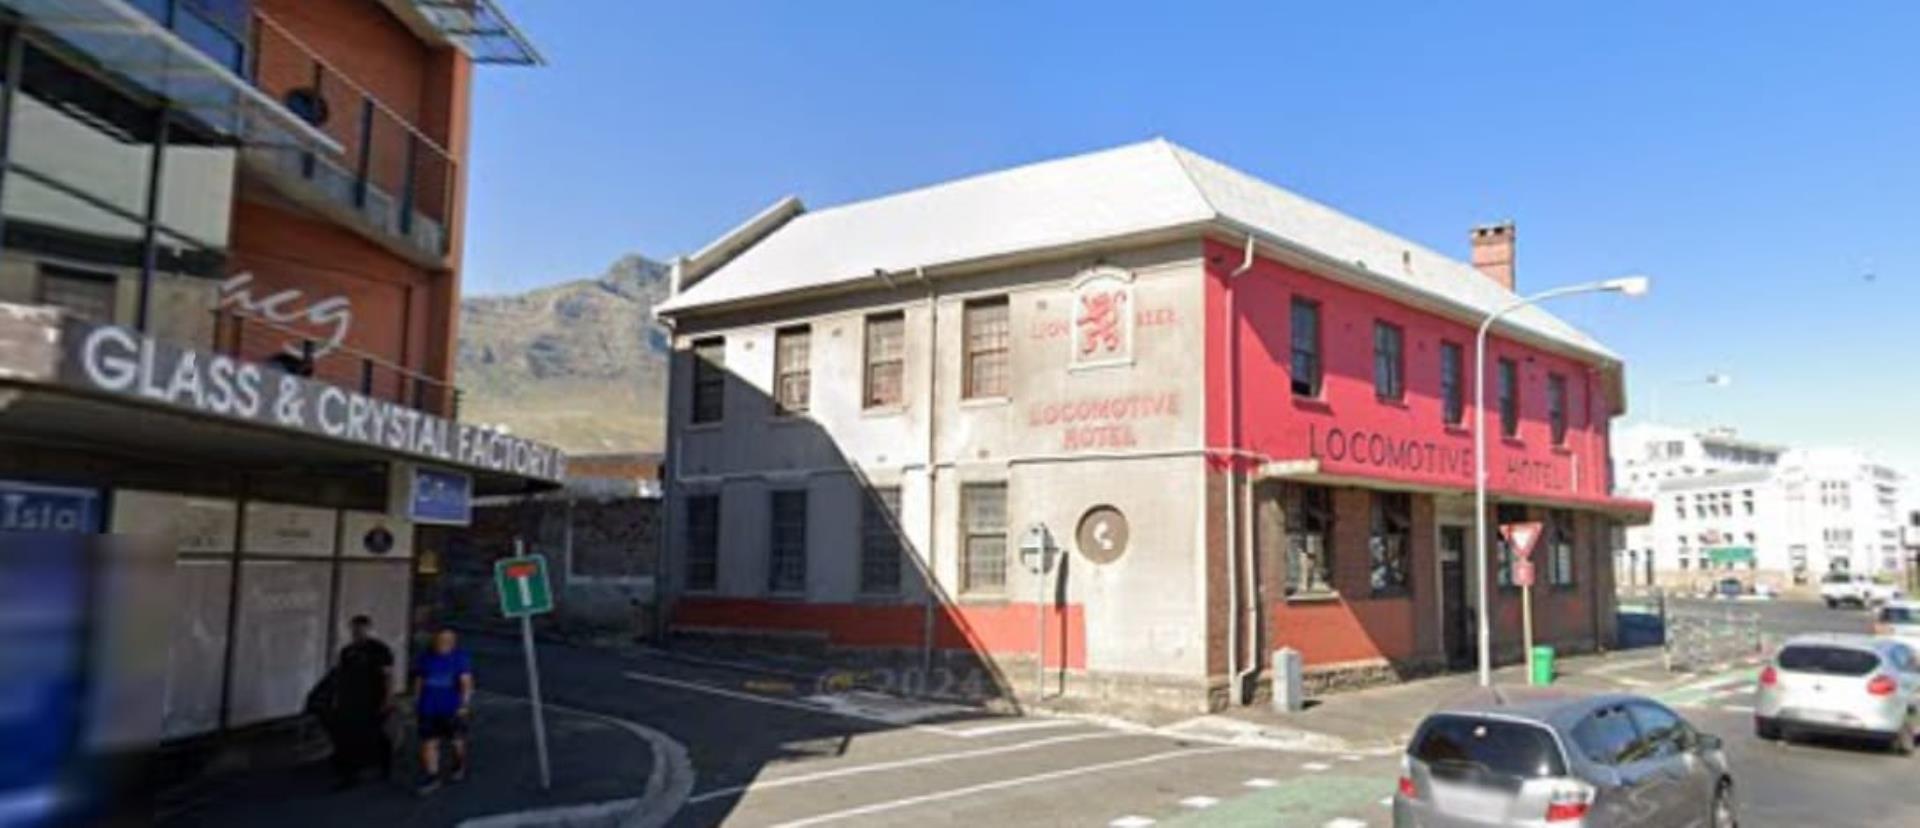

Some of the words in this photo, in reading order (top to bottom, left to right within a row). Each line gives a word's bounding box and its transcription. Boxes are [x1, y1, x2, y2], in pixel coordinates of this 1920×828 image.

[83, 324, 263, 418] GLASS
[276, 372, 305, 426] &
[316, 384, 452, 459] CRYSTAL
[456, 425, 553, 481] FACTORY
[1029, 391, 1179, 427] LOCOMOTIVE
[1062, 424, 1138, 450] HOTEL
[1309, 421, 1473, 478] LOCOMOTIVE
[1505, 454, 1566, 490] HOTEL
